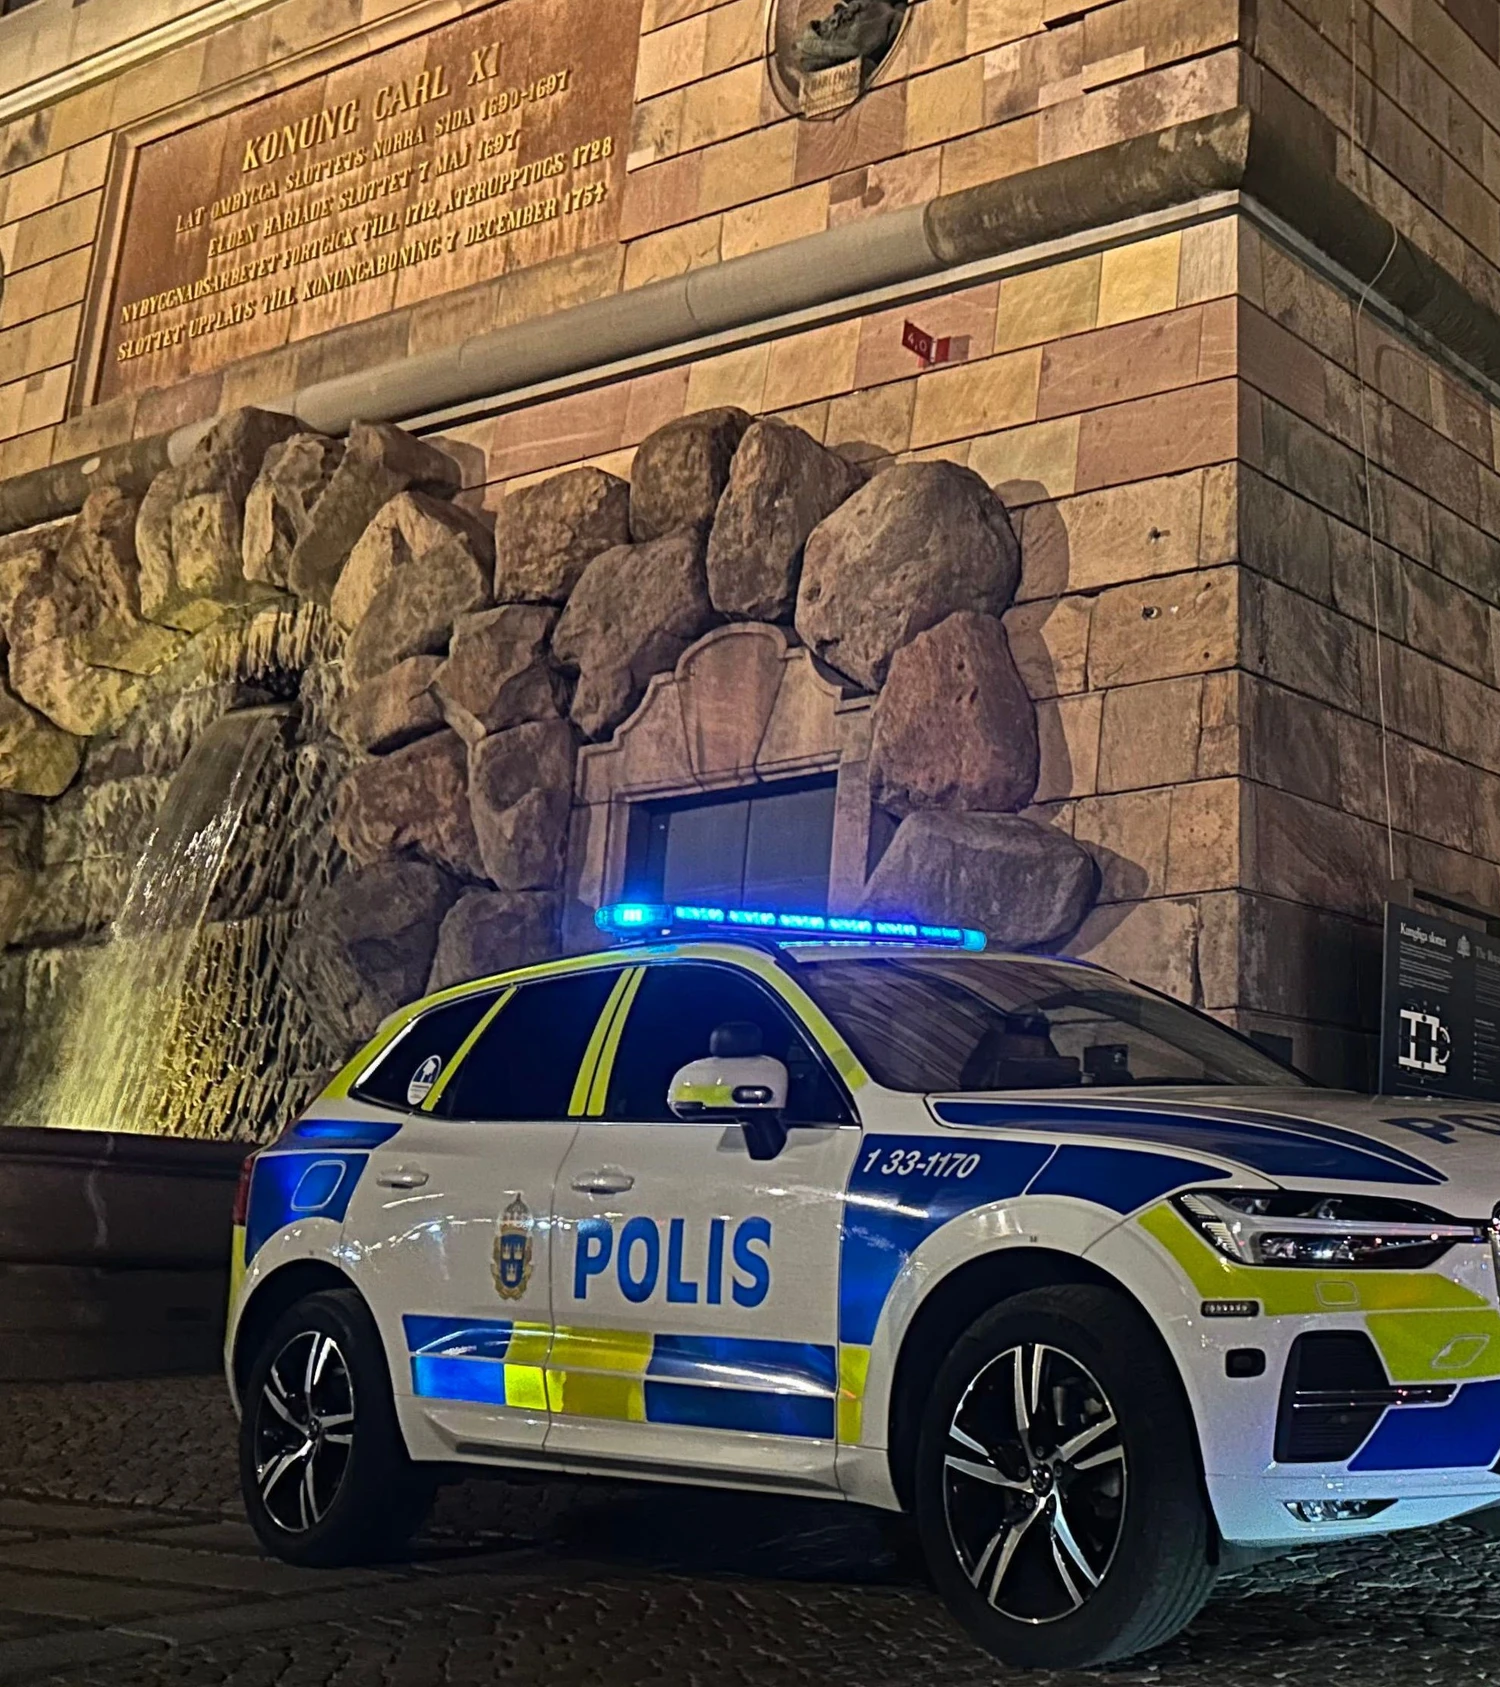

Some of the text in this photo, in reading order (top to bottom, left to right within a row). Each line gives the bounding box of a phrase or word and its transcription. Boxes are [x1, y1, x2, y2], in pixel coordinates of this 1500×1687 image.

[242, 41, 502, 173] KONUNG CARL XI
[285, 147, 367, 192] SLOTTETS
[372, 125, 426, 161] NORRA
[434, 107, 475, 138] SIDA
[208, 224, 257, 257] ELDEN
[338, 167, 412, 212] SLOTTET
[418, 160, 431, 183] 7
[435, 144, 471, 177] MAJ
[477, 129, 520, 162] 1697
[283, 229, 357, 270] FORTGICK
[361, 213, 400, 243] TILL
[572, 136, 615, 170] 1728
[117, 322, 186, 361] SLOTTET
[261, 285, 298, 316] TILL
[446, 231, 461, 252] 7
[463, 196, 559, 247] DECEMBER
[862, 1148, 980, 1179] 1 33-1170
[573, 1217, 771, 1308] POLIS
